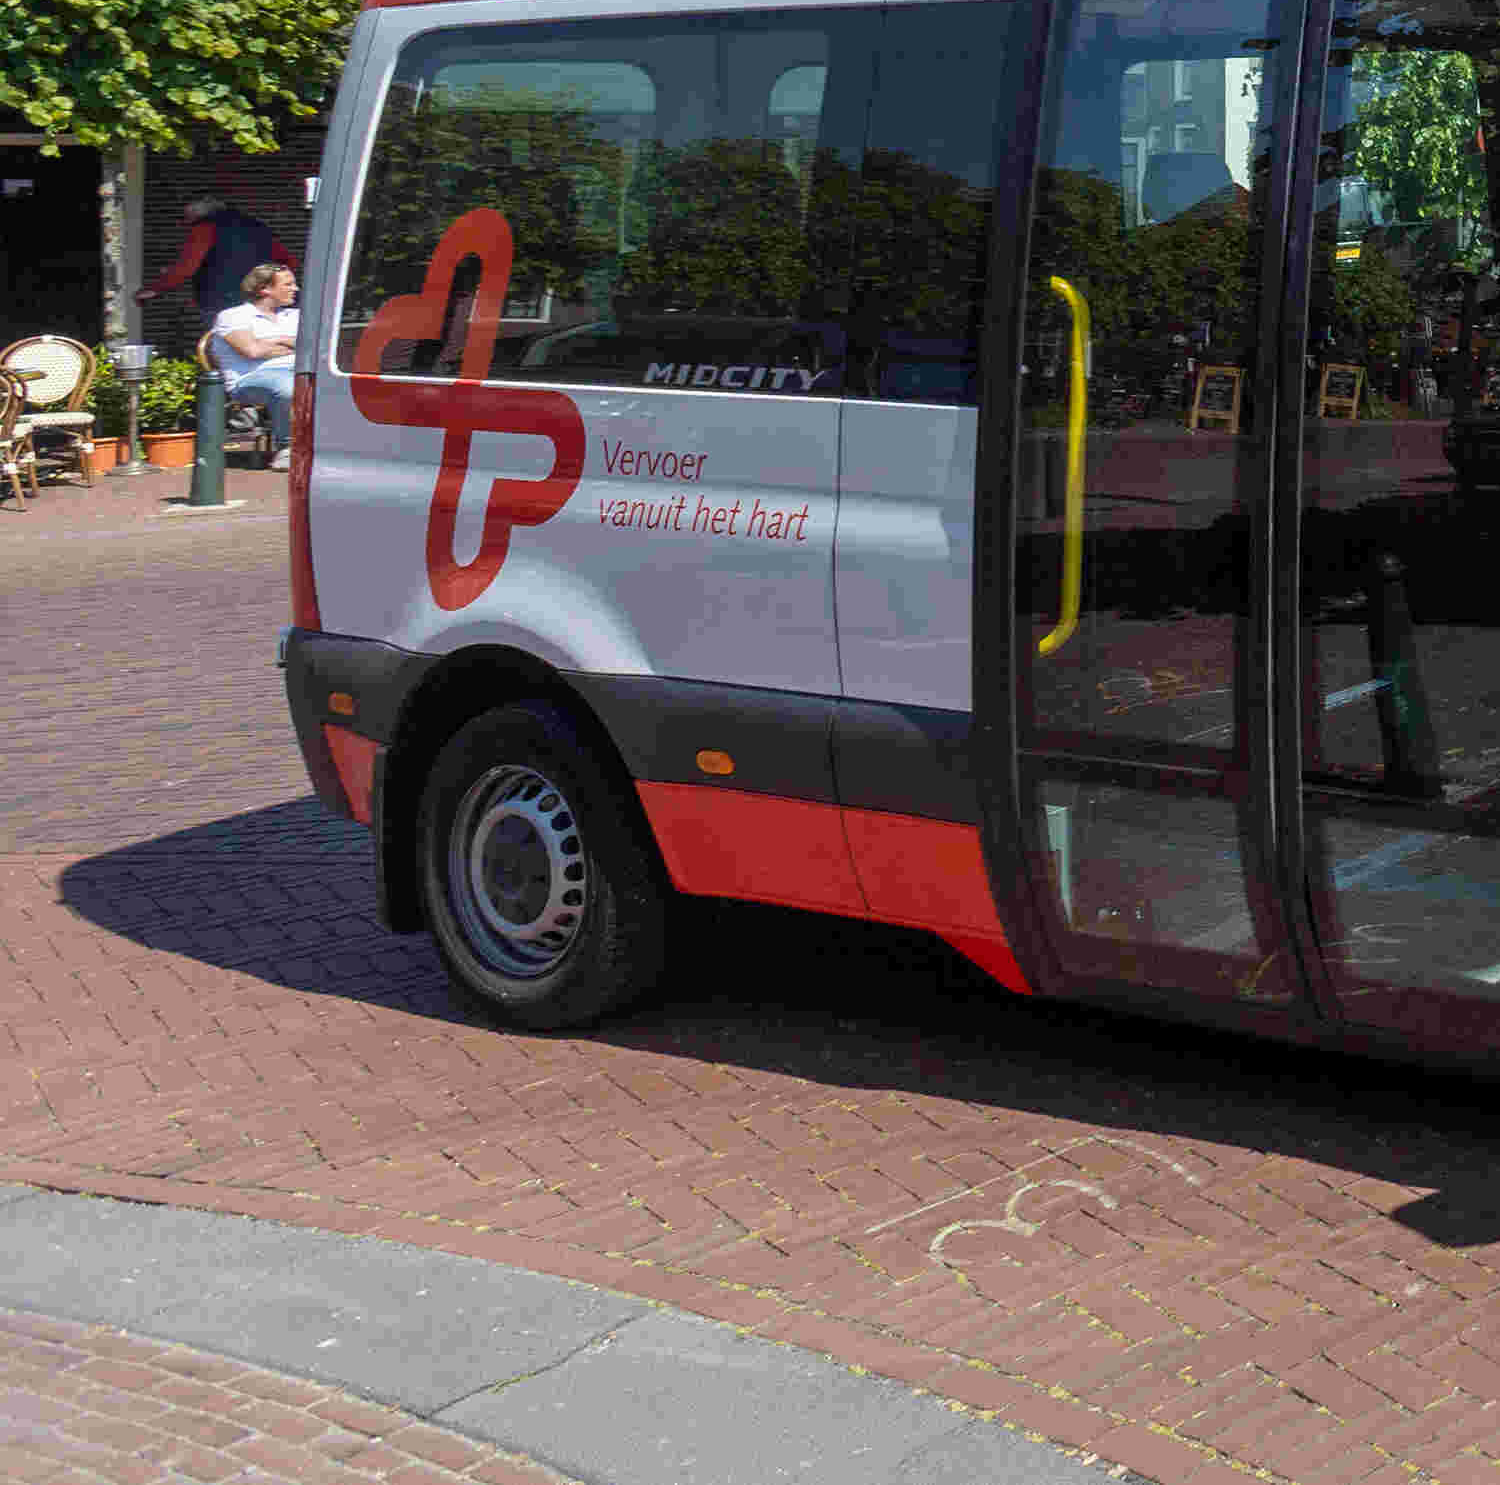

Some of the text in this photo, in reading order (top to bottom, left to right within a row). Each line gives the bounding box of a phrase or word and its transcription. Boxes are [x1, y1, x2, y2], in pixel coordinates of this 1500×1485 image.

[643, 362, 825, 390] MIDCITY
[602, 436, 709, 483] Vervoer
[599, 491, 810, 541] vanuit het hart
